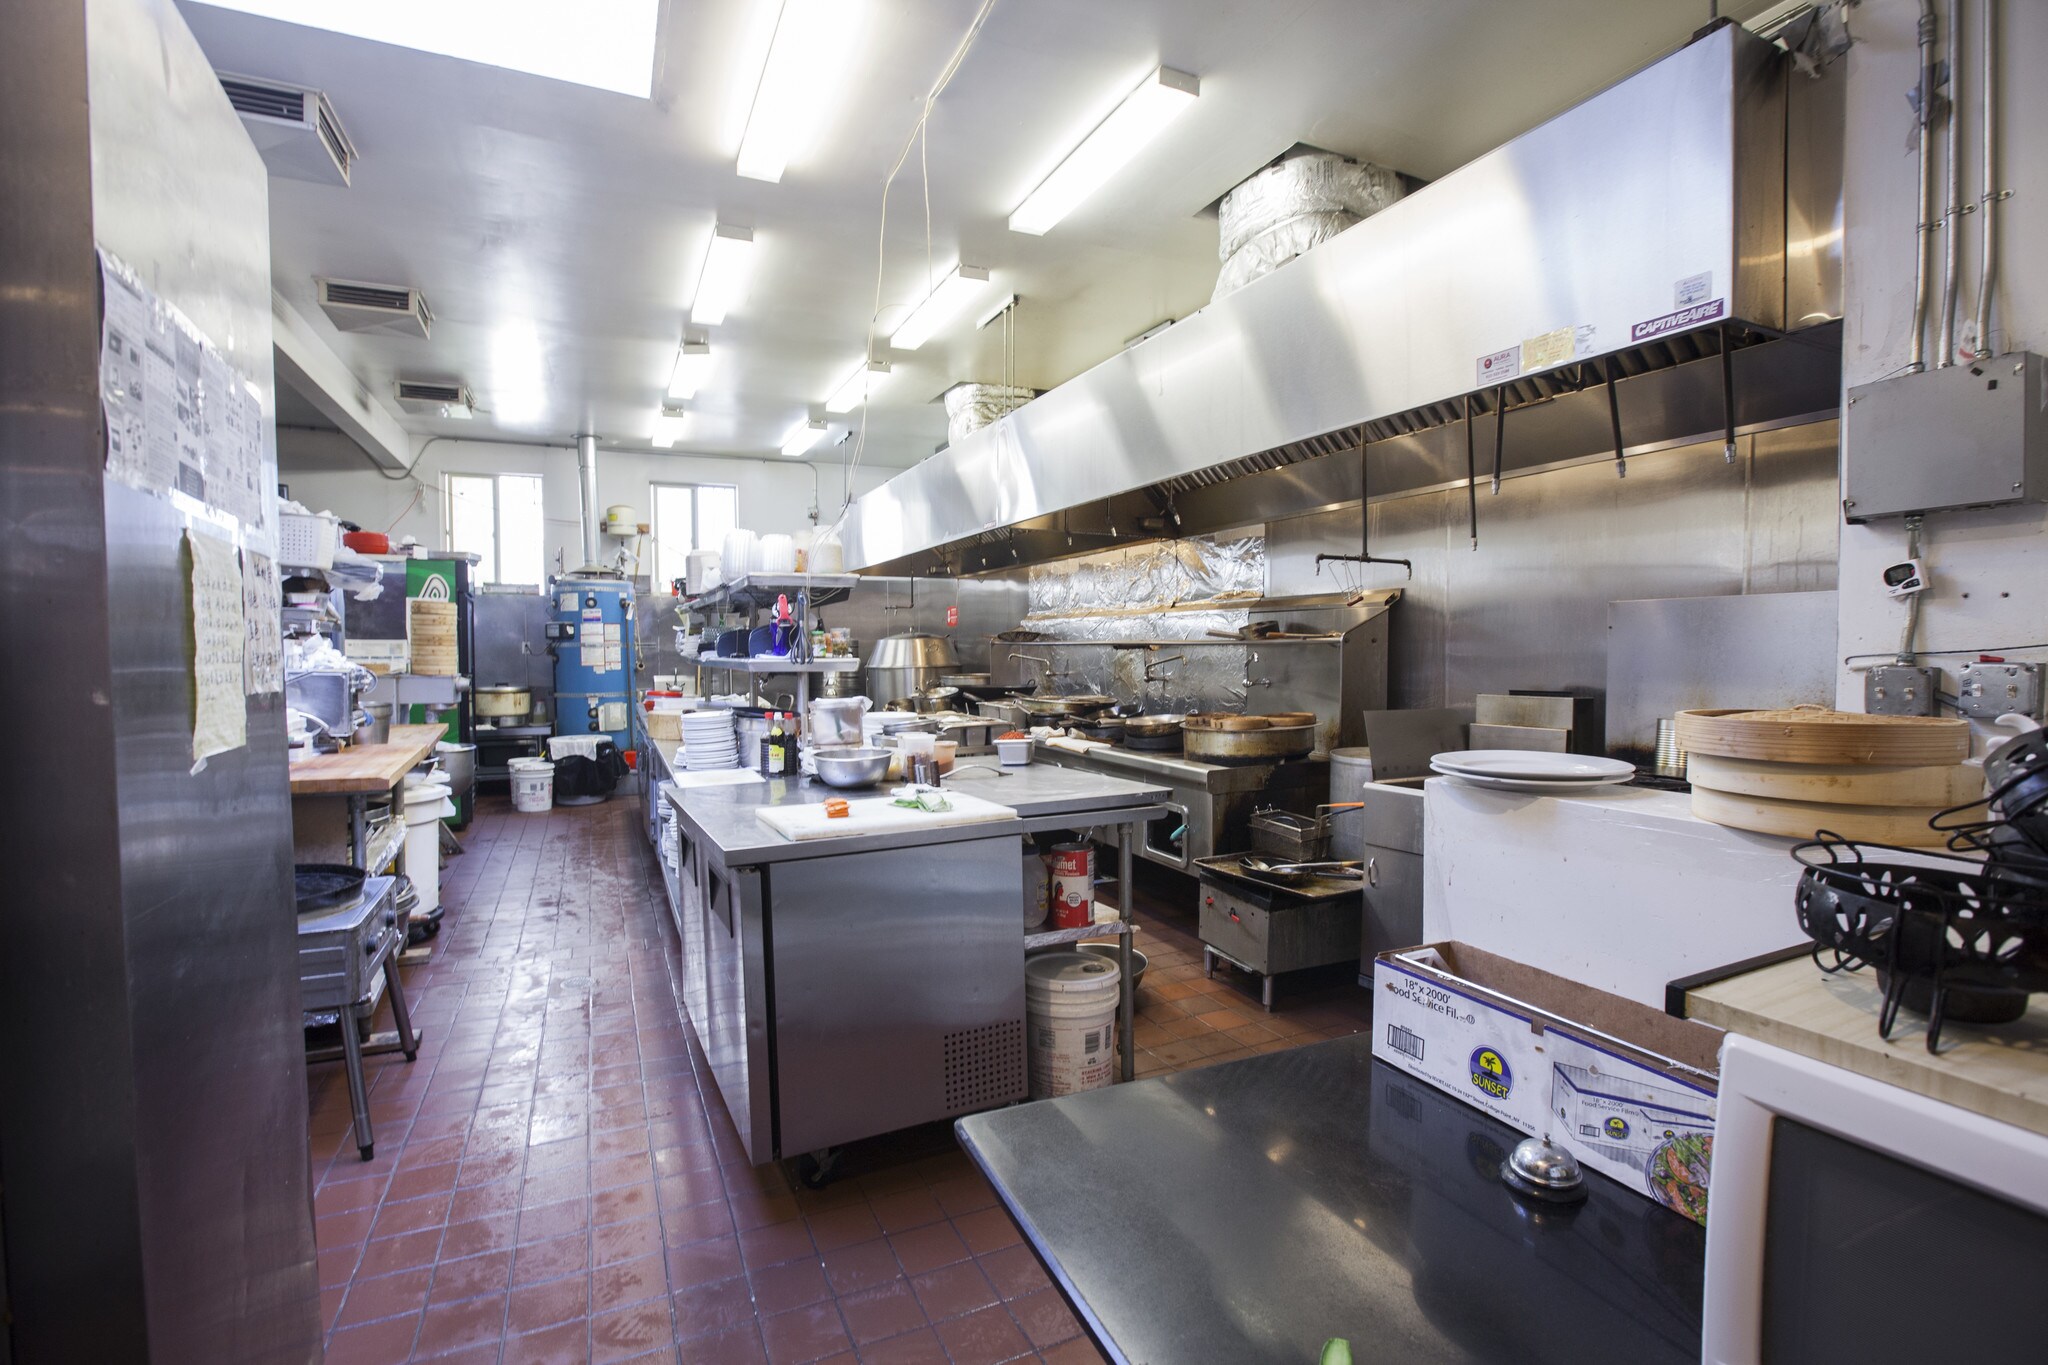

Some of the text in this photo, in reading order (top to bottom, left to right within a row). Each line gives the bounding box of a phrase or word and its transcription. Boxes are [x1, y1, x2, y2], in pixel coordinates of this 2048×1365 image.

[1635, 301, 1720, 337] CAPTIVEAIRE
[1388, 984, 1464, 1022] ood Sevice Fil
[1404, 978, 1451, 1004] 18" x 2000'
[1472, 1073, 1509, 1099] SUNSET
